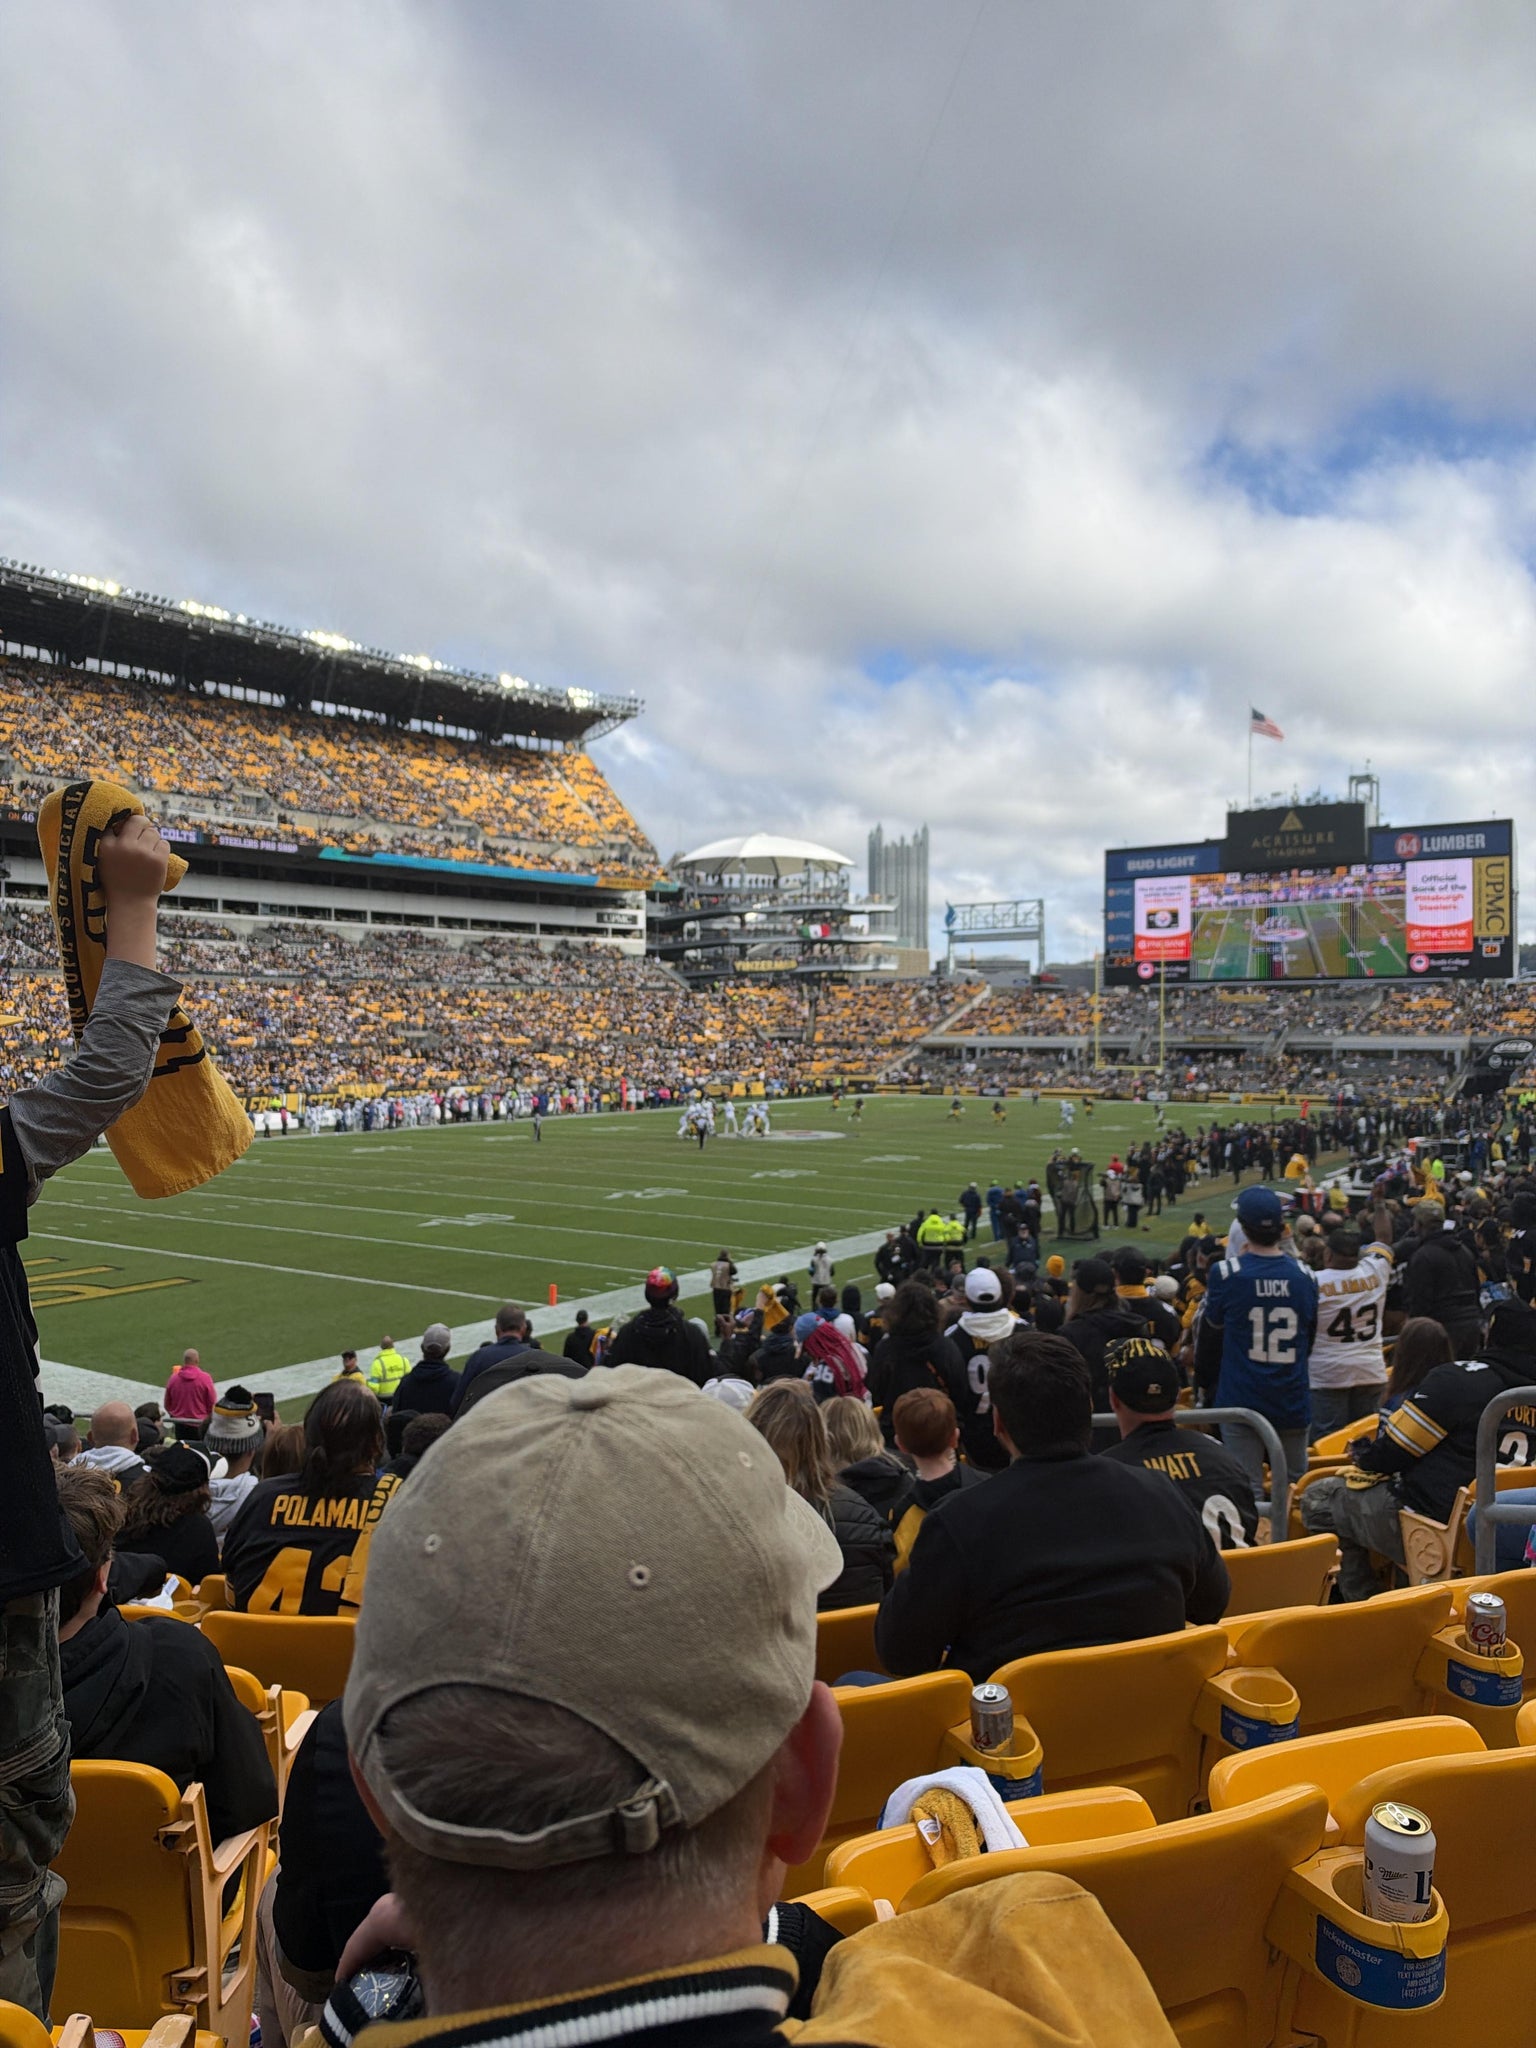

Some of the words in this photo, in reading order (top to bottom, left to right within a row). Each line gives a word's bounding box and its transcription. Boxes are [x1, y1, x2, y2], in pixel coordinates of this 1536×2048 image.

[21, 812, 35, 823] 46
[159, 827, 197, 843] COLTS
[1252, 831, 1336, 848] ACRISURE
[1400, 836, 1417, 852] 84
[1422, 833, 1486, 853] LUMBER
[58, 790, 84, 907] OFFICIAL
[219, 835, 259, 850] STEELERS
[260, 839, 276, 851] PRO
[277, 842, 298, 853] SHOP
[1266, 846, 1317, 858] STADIUM
[1126, 858, 1155, 871] BUD
[1156, 855, 1197, 870] LIGHT
[1421, 874, 1457, 883] Official
[1411, 884, 1435, 892] Bank
[1413, 893, 1465, 902] Pittsburgh
[1485, 861, 1506, 932] UPMC
[603, 913, 631, 924] UPMC
[1442, 928, 1467, 938] BANK
[1255, 1279, 1290, 1298] LUCK
[1327, 1303, 1378, 1343] 43
[1248, 1306, 1298, 1364] 12
[1143, 1452, 1202, 1481] WATT
[1378, 1867, 1409, 1881] Miller
[1323, 1925, 1384, 1966] ticketmaster
[1397, 1971, 1411, 1979] TEXT
